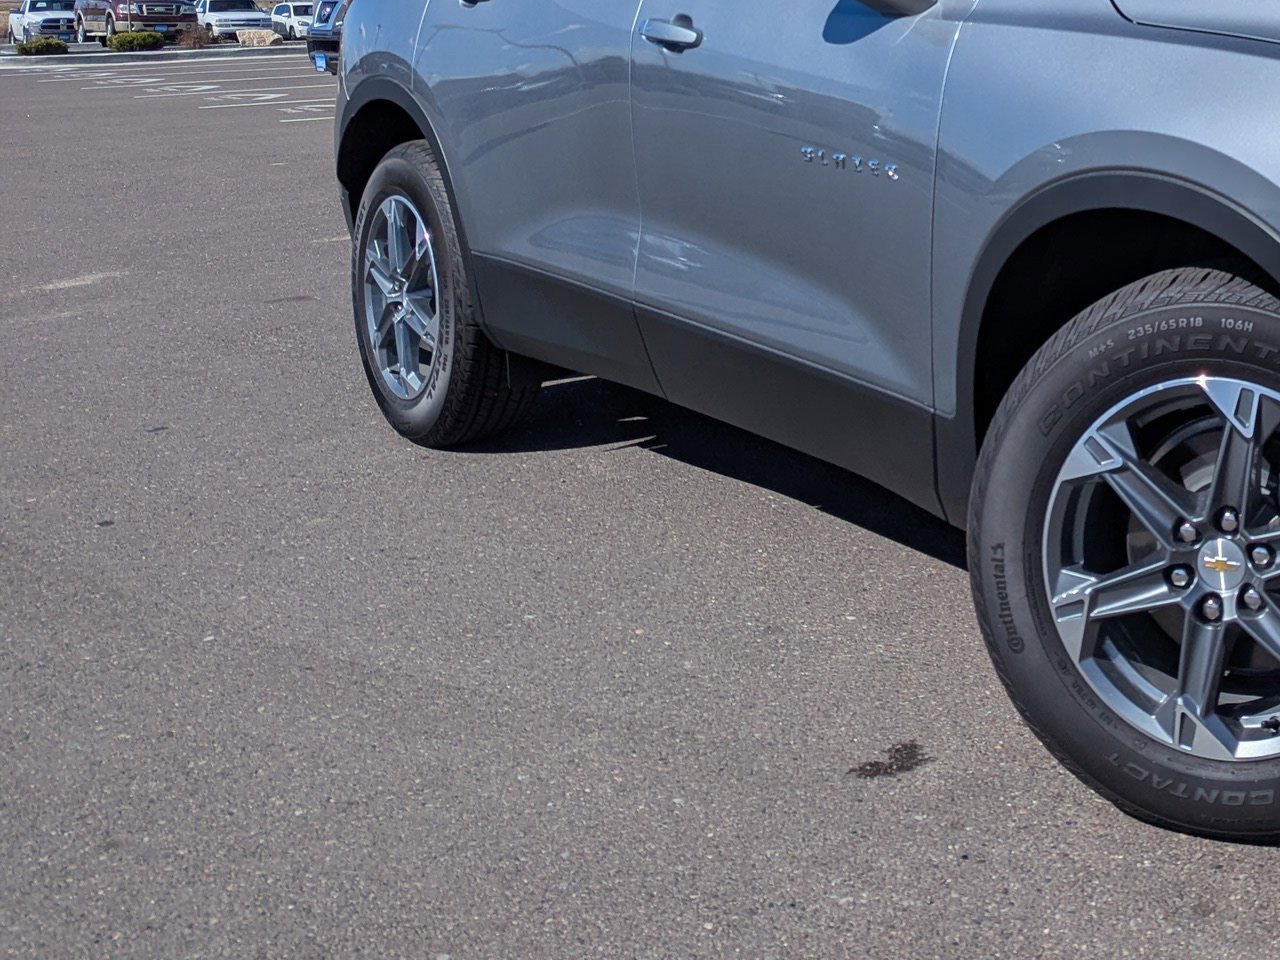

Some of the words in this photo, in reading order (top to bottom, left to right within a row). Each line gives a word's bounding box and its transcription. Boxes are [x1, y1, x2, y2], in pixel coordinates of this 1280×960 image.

[1088, 338, 1115, 359] M+S
[1128, 316, 1203, 340] 235/65R18
[1221, 317, 1254, 332] 106H
[991, 554, 1025, 654] Continental
[1103, 752, 1275, 806] CONTACT
